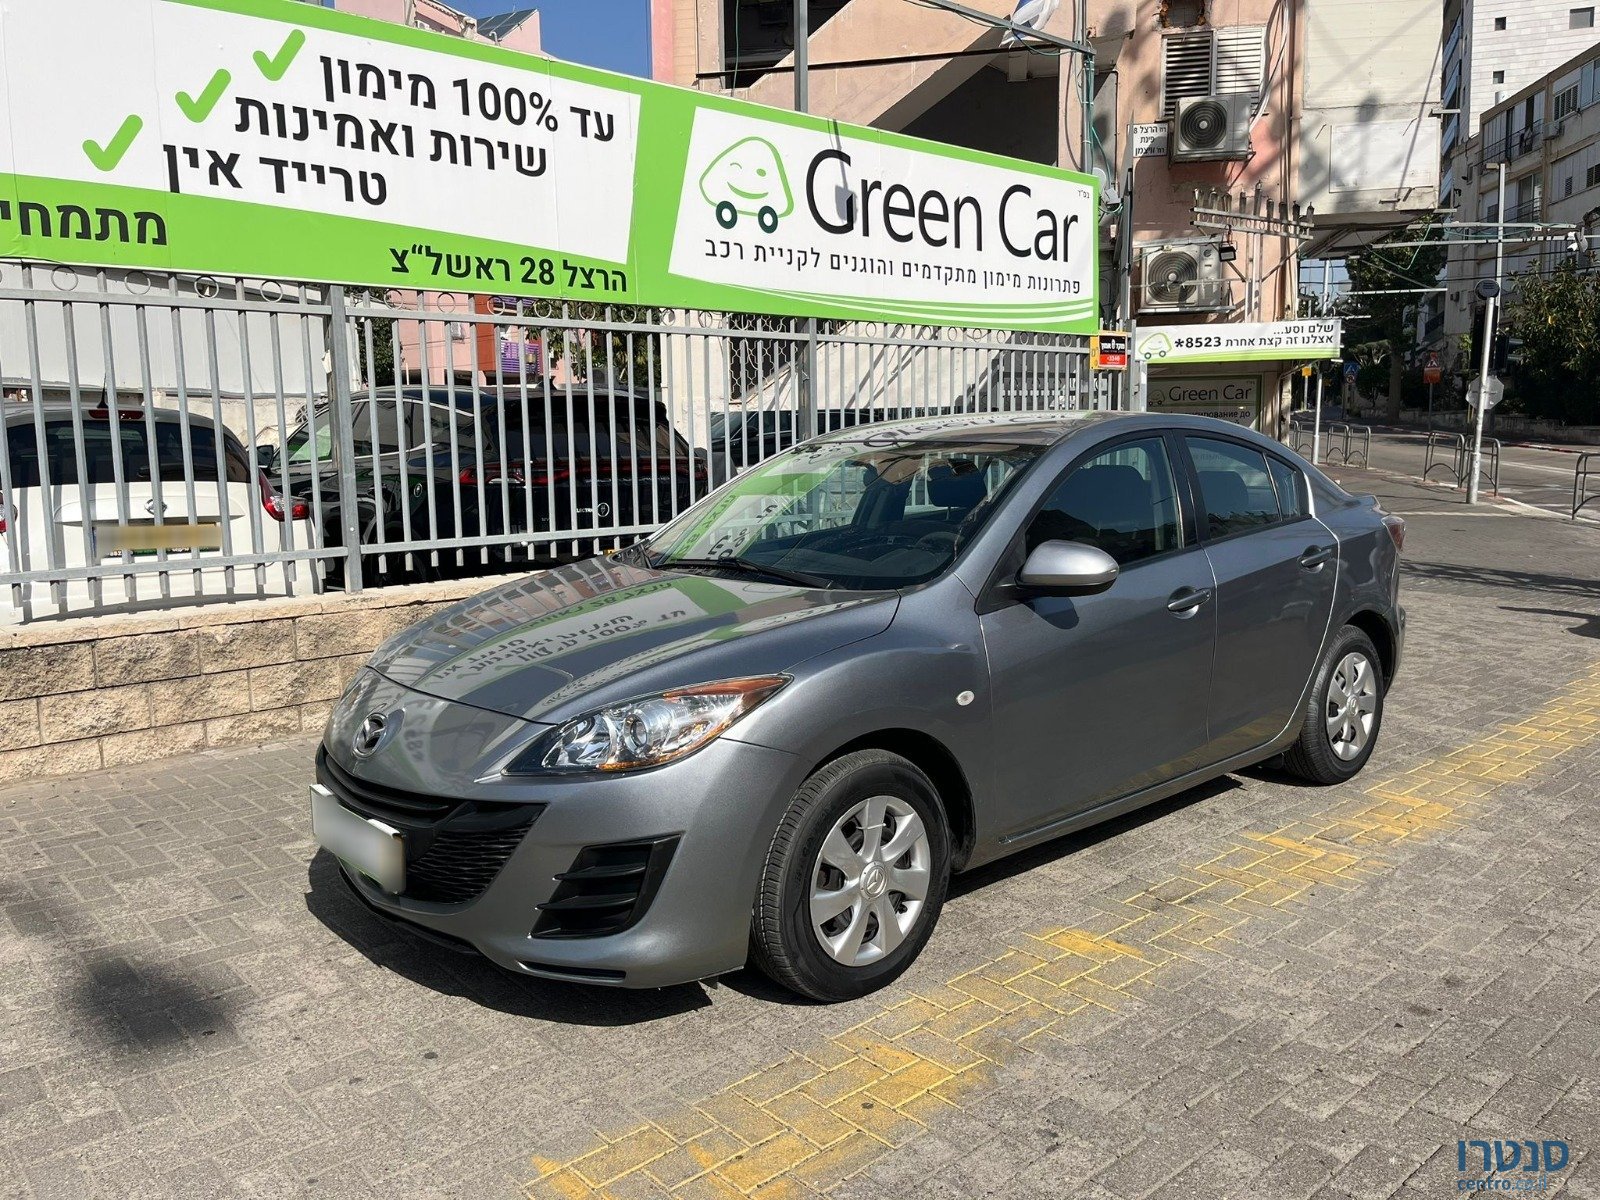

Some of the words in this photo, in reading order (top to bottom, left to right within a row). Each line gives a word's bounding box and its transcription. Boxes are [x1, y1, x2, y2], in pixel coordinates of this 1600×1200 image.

[319, 55, 437, 111] מימון
[452, 78, 559, 132] 100%
[236, 96, 414, 158] ואמינות
[569, 105, 615, 142] עד
[429, 129, 547, 177] שירות
[162, 144, 243, 194] אין
[259, 156, 388, 206] טרייד
[805, 148, 983, 252] Green
[997, 184, 1079, 263] Car
[705, 238, 744, 260] רכב
[754, 245, 820, 271] לקניית
[520, 256, 555, 285] 28
[562, 258, 627, 292] הרצל
[830, 253, 893, 275] והוגנים
[902, 262, 976, 286] מתקדמים
[983, 270, 1021, 289] מימון
[1027, 275, 1081, 294] פתרונות
[1285, 335, 1298, 344] זה
[1302, 334, 1333, 344] אצלנו
[1308, 323, 1334, 333] שלם
[1225, 338, 1255, 347] אחרת
[1259, 336, 1282, 347] קצת
[1168, 386, 1218, 401] Green
[1223, 384, 1252, 400] Car
